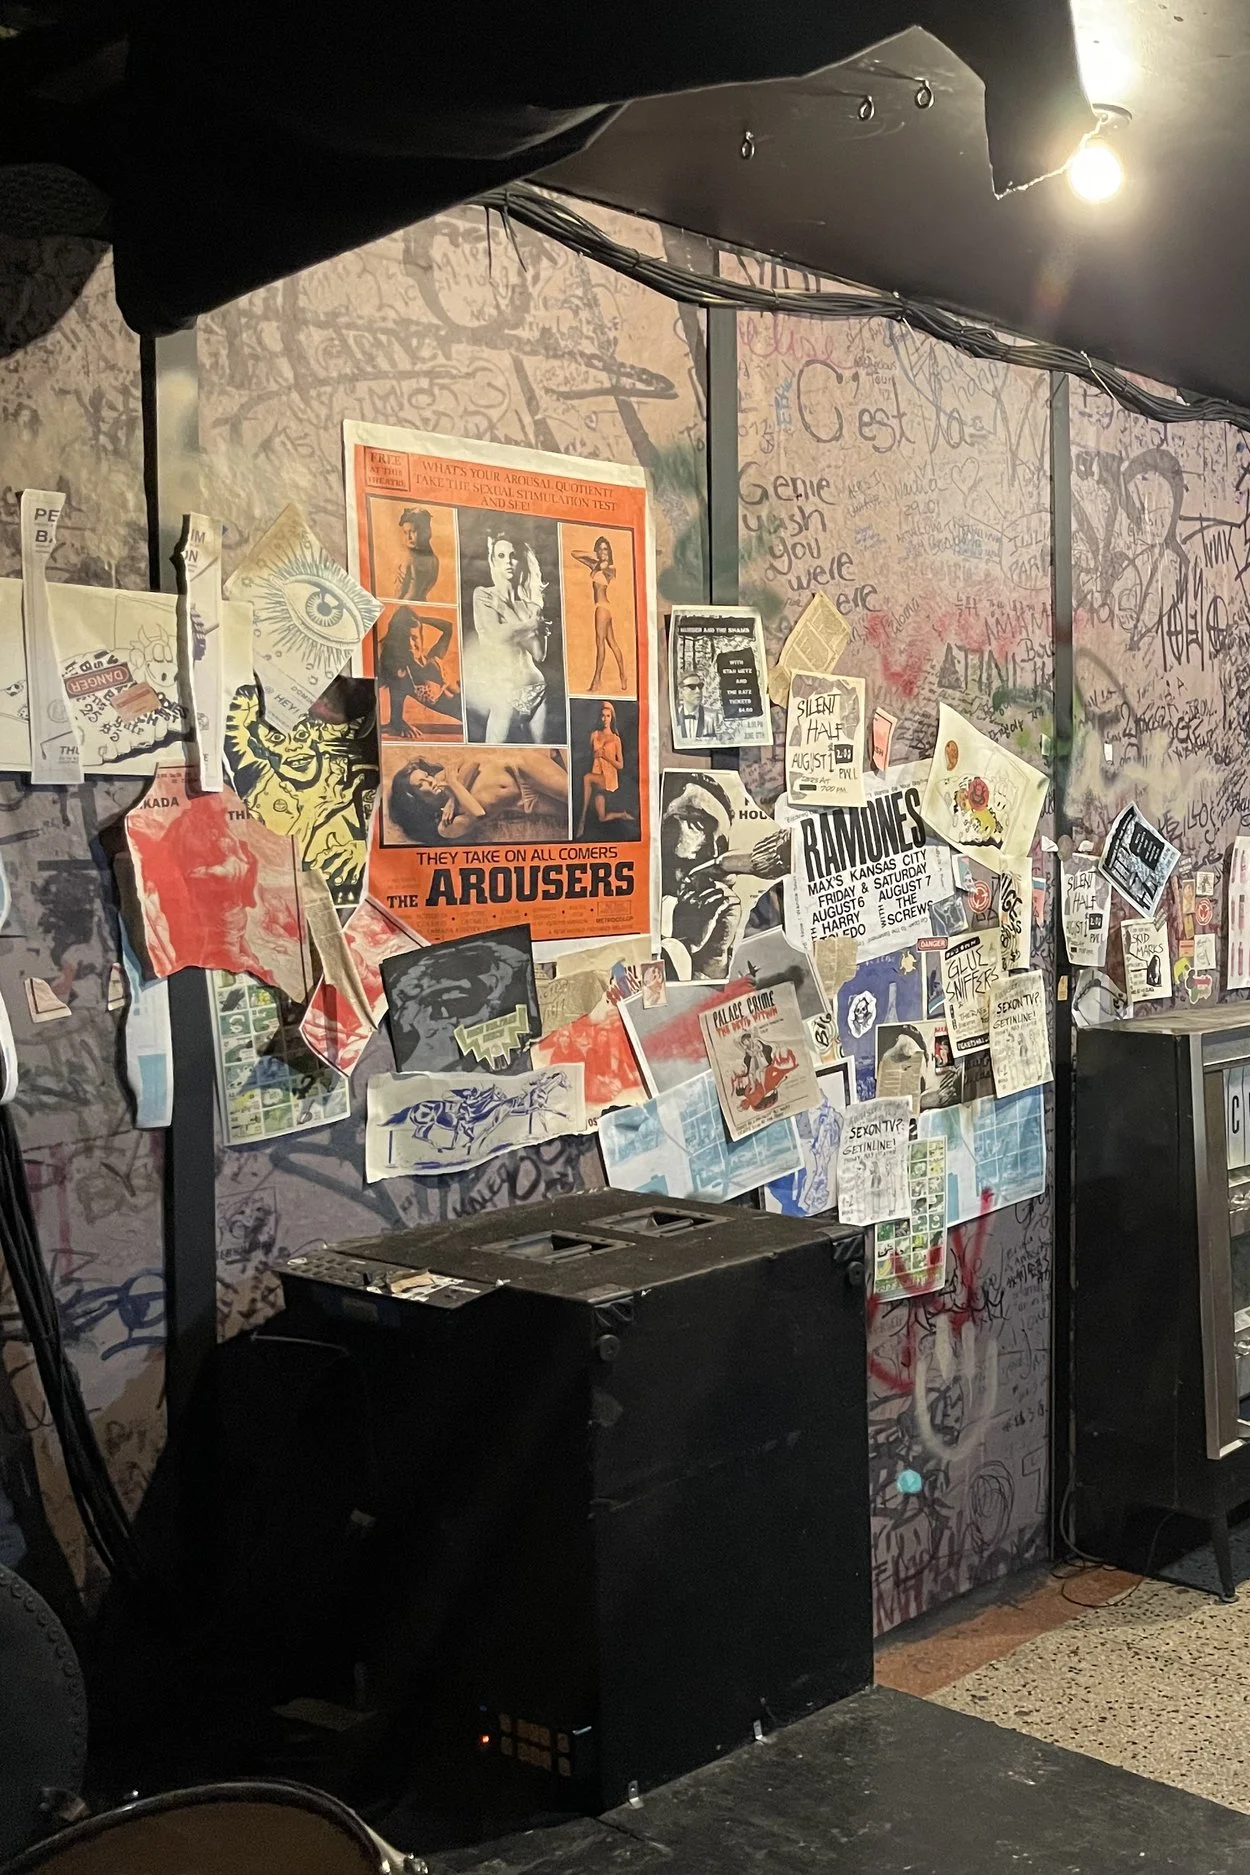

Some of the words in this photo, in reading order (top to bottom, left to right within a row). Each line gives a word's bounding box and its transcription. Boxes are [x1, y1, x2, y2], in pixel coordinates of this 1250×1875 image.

[370, 452, 402, 466] FREE
[416, 473, 445, 489] TAKE
[447, 478, 470, 492] THE
[473, 482, 514, 499] SEXUAL
[516, 489, 590, 509] STIMULATION
[591, 499, 618, 512] TEST
[422, 461, 468, 477] WHAT'S
[469, 468, 501, 482] YOUR
[503, 473, 551, 490] AROUSAL
[555, 481, 614, 498] QUOTIENT?
[480, 496, 506, 508] AND
[768, 536, 821, 576] you
[788, 552, 856, 592] were
[836, 584, 884, 616] ere
[70, 669, 124, 692] DANGER
[273, 693, 301, 715] HEY!
[797, 693, 842, 718] SILENT
[806, 719, 843, 744] HALF
[791, 752, 828, 774] AUGUST
[140, 797, 179, 809] KADA
[800, 788, 927, 883] RAMONES
[416, 852, 458, 866] THEY
[462, 849, 501, 864] TAKE
[505, 848, 527, 863] ON
[531, 847, 557, 862] ALL
[558, 846, 618, 861] COMERS
[386, 894, 419, 909] THE
[425, 861, 635, 907] AROUSERS
[808, 874, 844, 896] MAX'S
[850, 858, 897, 881] KANSAS
[902, 848, 927, 866] CITY
[818, 884, 856, 908] FRIDAY
[861, 882, 870, 894] &
[873, 862, 927, 889] SATURDAY
[879, 878, 922, 902] AUGUST
[925, 875, 931, 886] 7
[812, 898, 857, 925] AUGUST
[858, 896, 865, 908] 6
[878, 904, 887, 929] WITH
[896, 892, 918, 909] THE
[887, 900, 934, 926] SCREWS
[1072, 892, 1097, 914] HALF
[821, 910, 860, 935] HARRY
[919, 939, 947, 949] DANGER
[1131, 933, 1150, 944] SKID
[1136, 944, 1164, 958] MARKS
[947, 945, 989, 979] GLUE
[945, 967, 1000, 1002] SNIFFERS
[712, 1001, 745, 1029] PALACE
[746, 990, 776, 1014] CRIME
